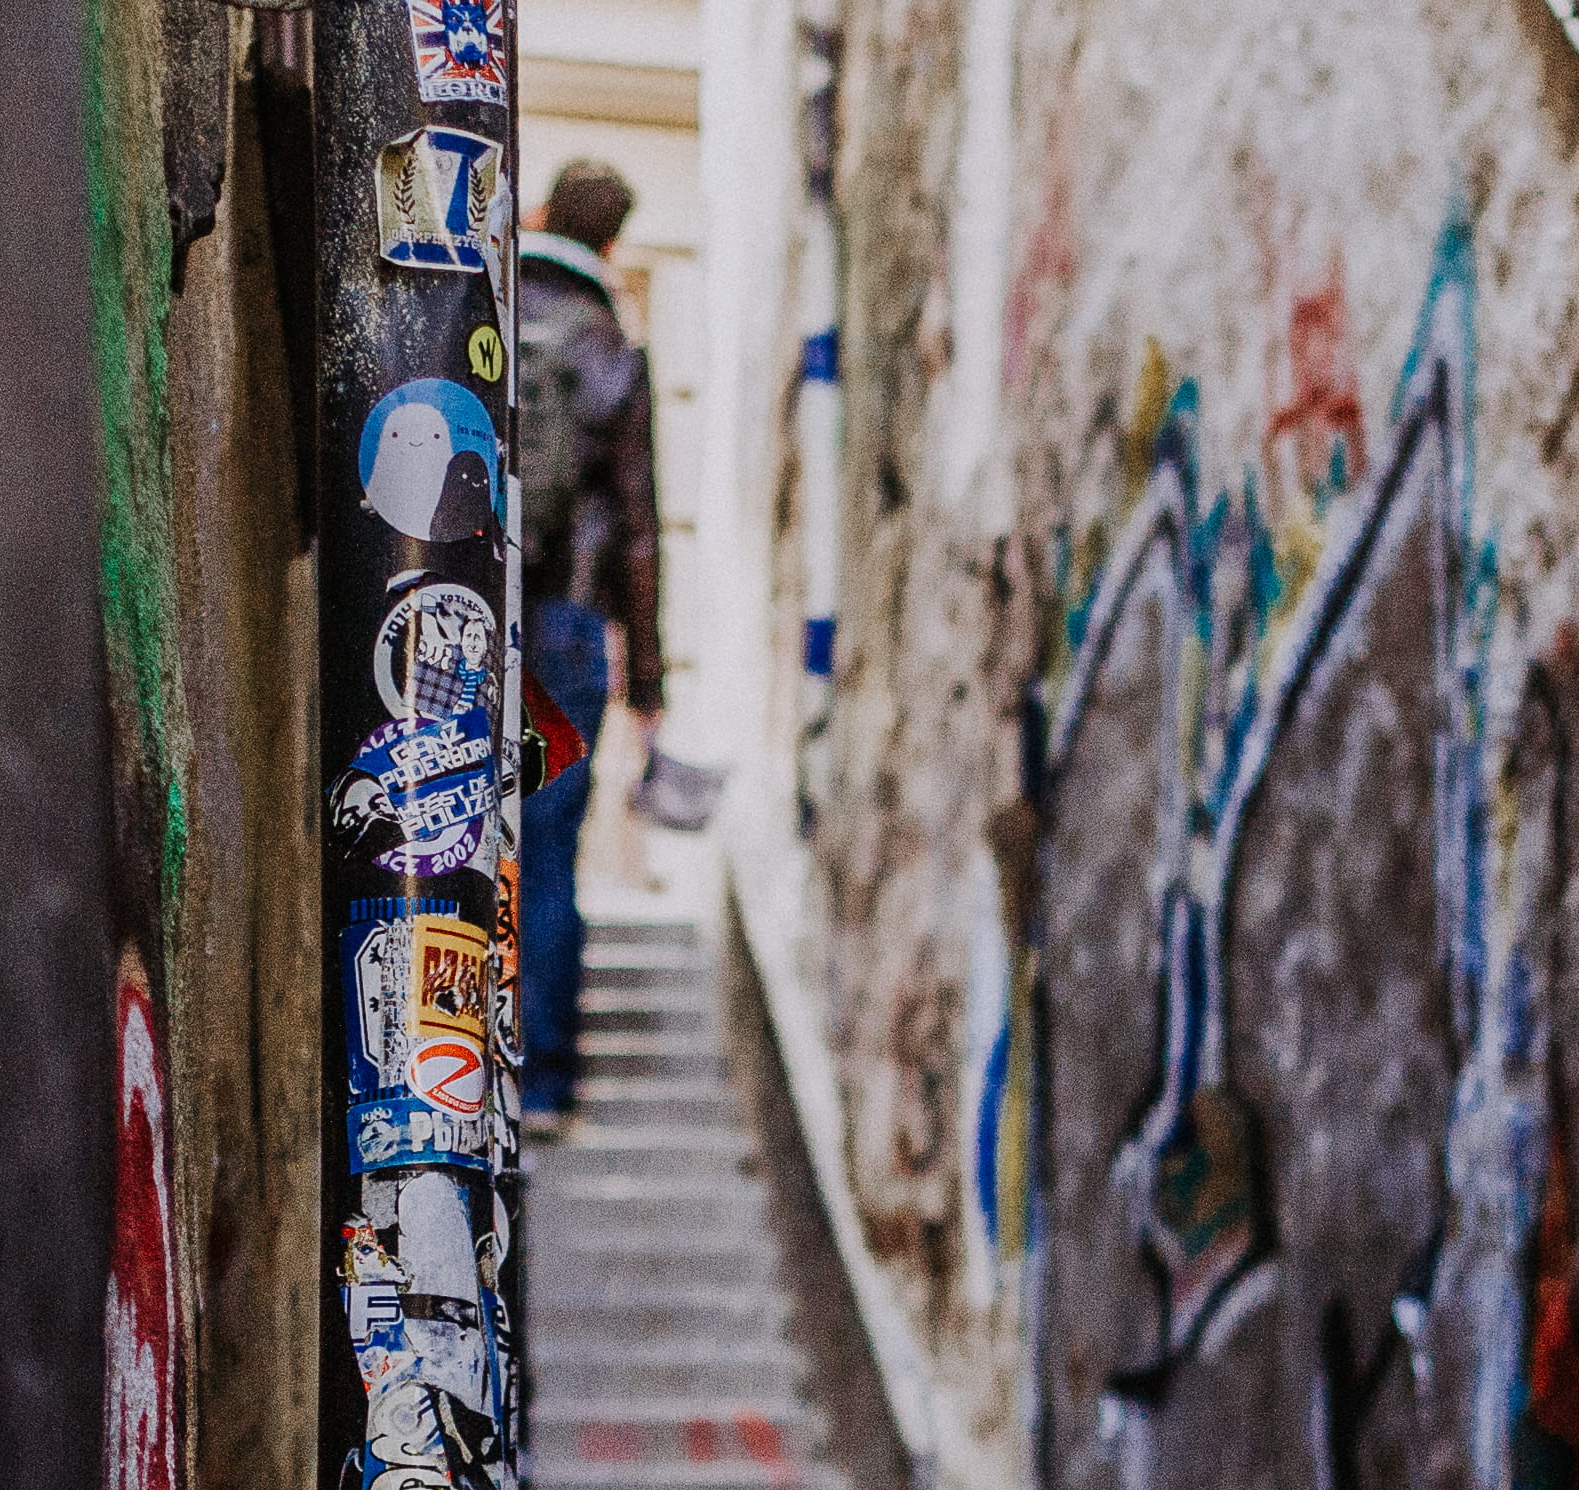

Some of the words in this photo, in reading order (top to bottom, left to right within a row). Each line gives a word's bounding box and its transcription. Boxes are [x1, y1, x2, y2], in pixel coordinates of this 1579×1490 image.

[378, 735, 493, 793] PADERBORN
[389, 719, 465, 767] GANZ
[431, 832, 476, 874] 2002
